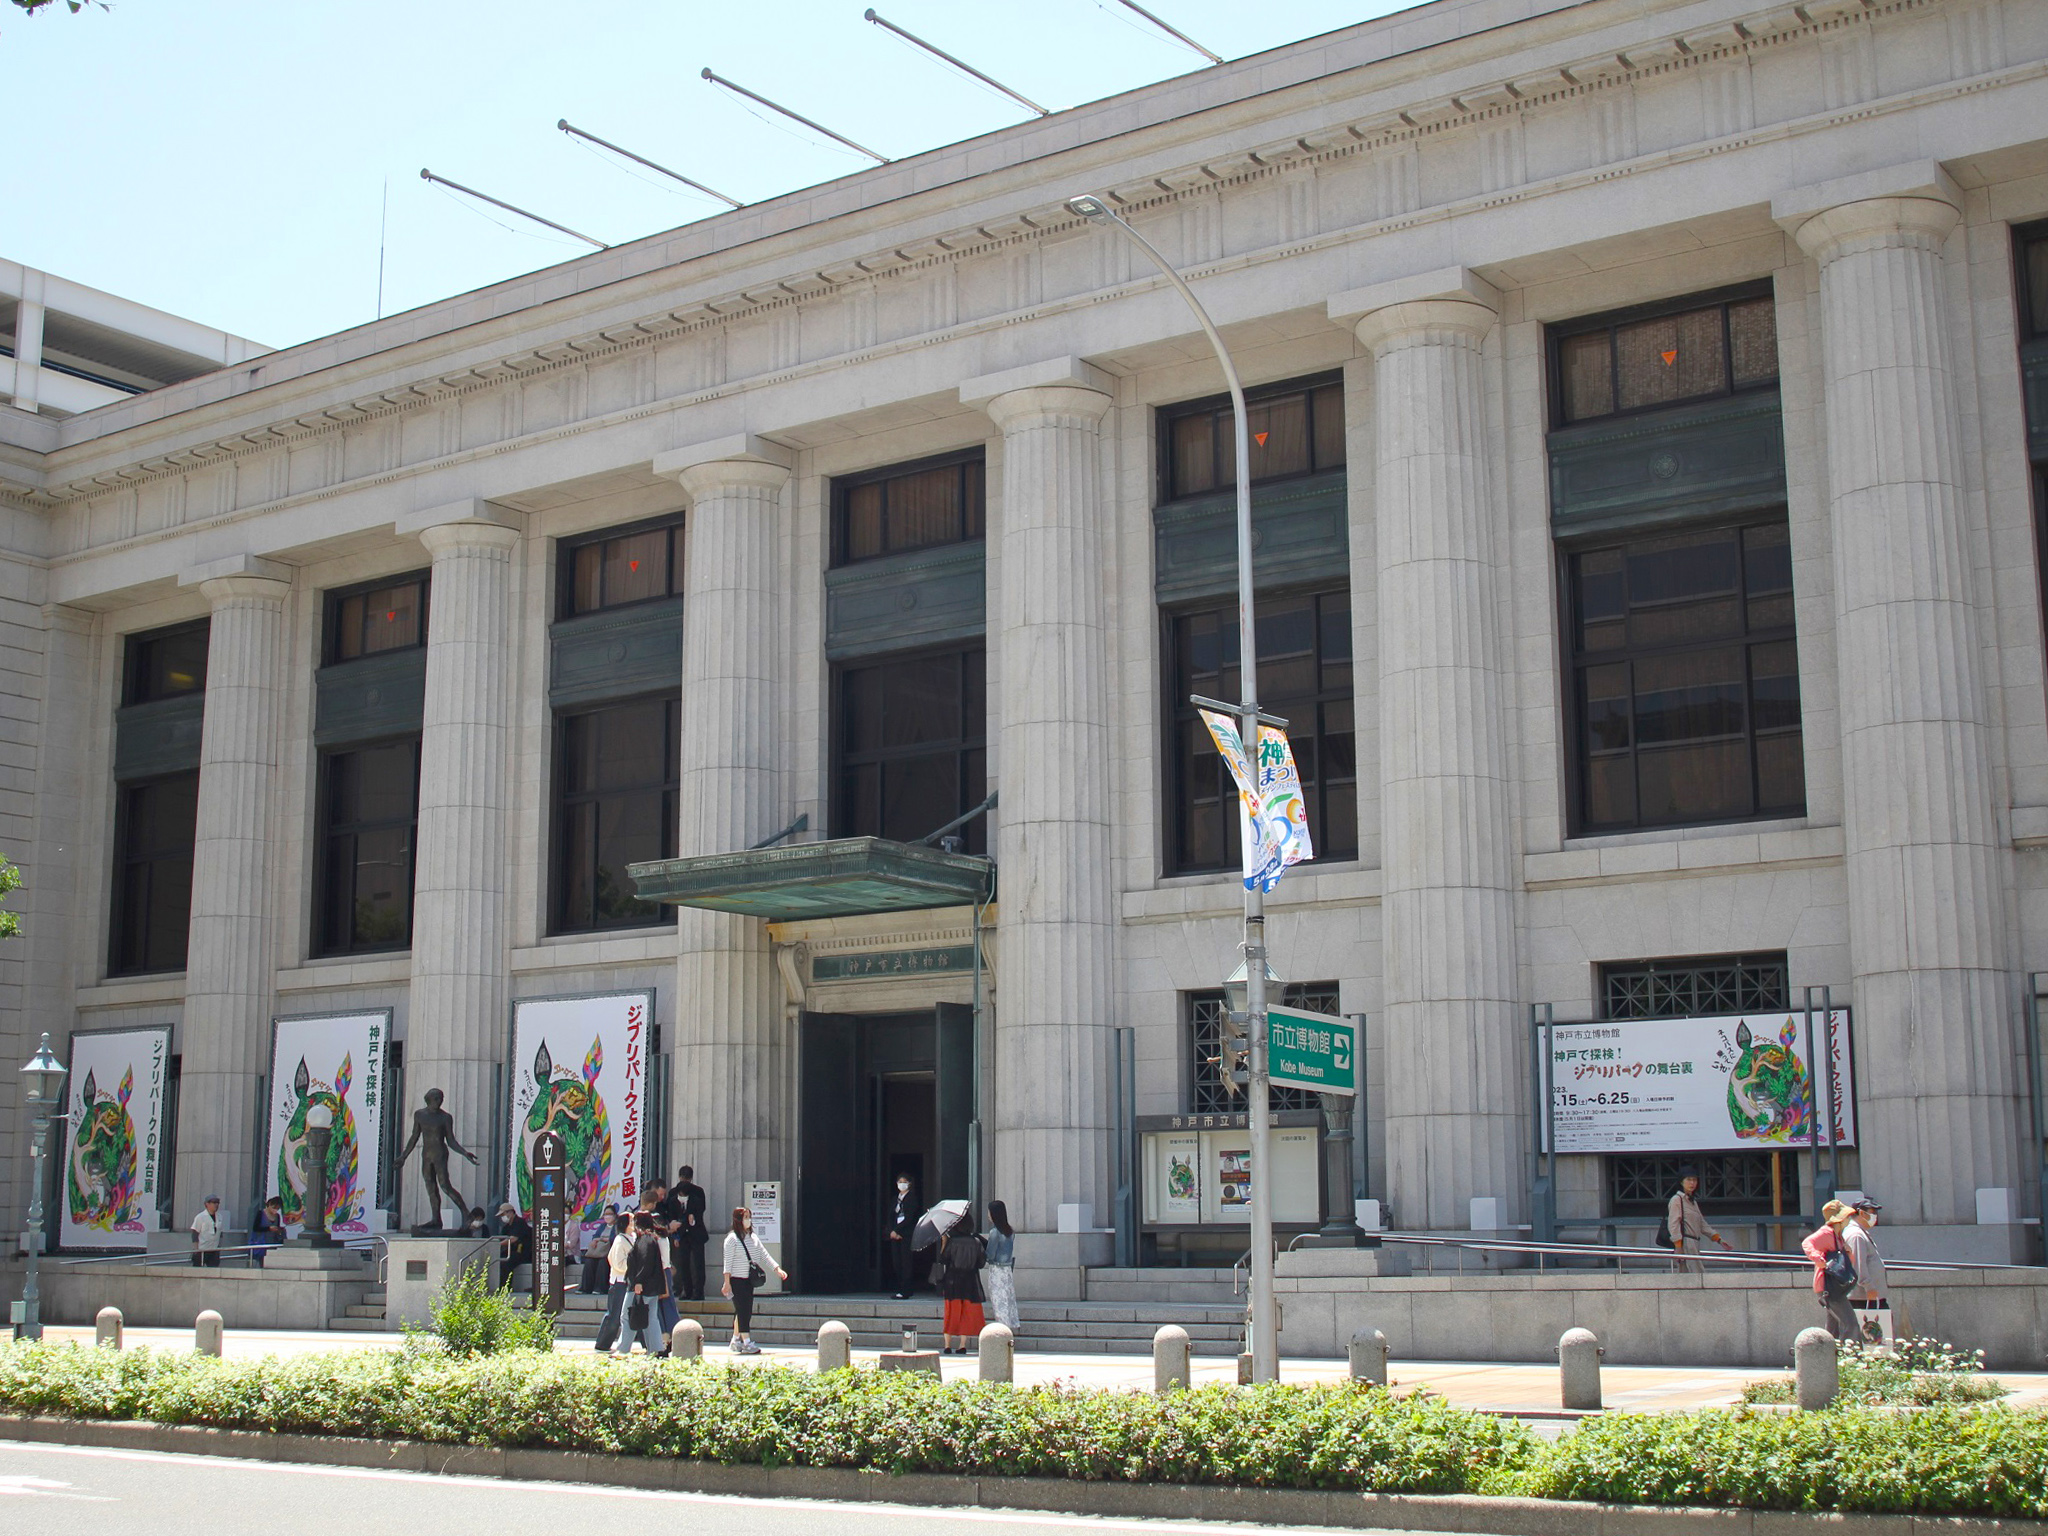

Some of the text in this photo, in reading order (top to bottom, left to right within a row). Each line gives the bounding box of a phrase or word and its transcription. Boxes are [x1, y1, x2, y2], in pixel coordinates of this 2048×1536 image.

[1258, 739, 1291, 767] 神
[1260, 766, 1297, 786] まつり
[849, 953, 949, 973] 神戸市立博物館
[1272, 1022, 1331, 1055] 市立博物館
[1555, 1028, 1621, 1041] 神戸市立博物館
[1554, 1048, 1622, 1062] 神戸で探検！
[365, 1025, 380, 1123] 神戸で探検！
[1280, 1059, 1324, 1078] Kobe Museum
[620, 1004, 643, 1199] ジブリパークとジブリ展
[1553, 1086, 1568, 1094] 023.
[144, 1039, 163, 1194] ジブリパークの舞台裏
[1172, 1113, 1279, 1128] 神戸市立博館
[539, 1207, 550, 1295] 神戸市立博物館前
[551, 1227, 560, 1266] 京町筋
